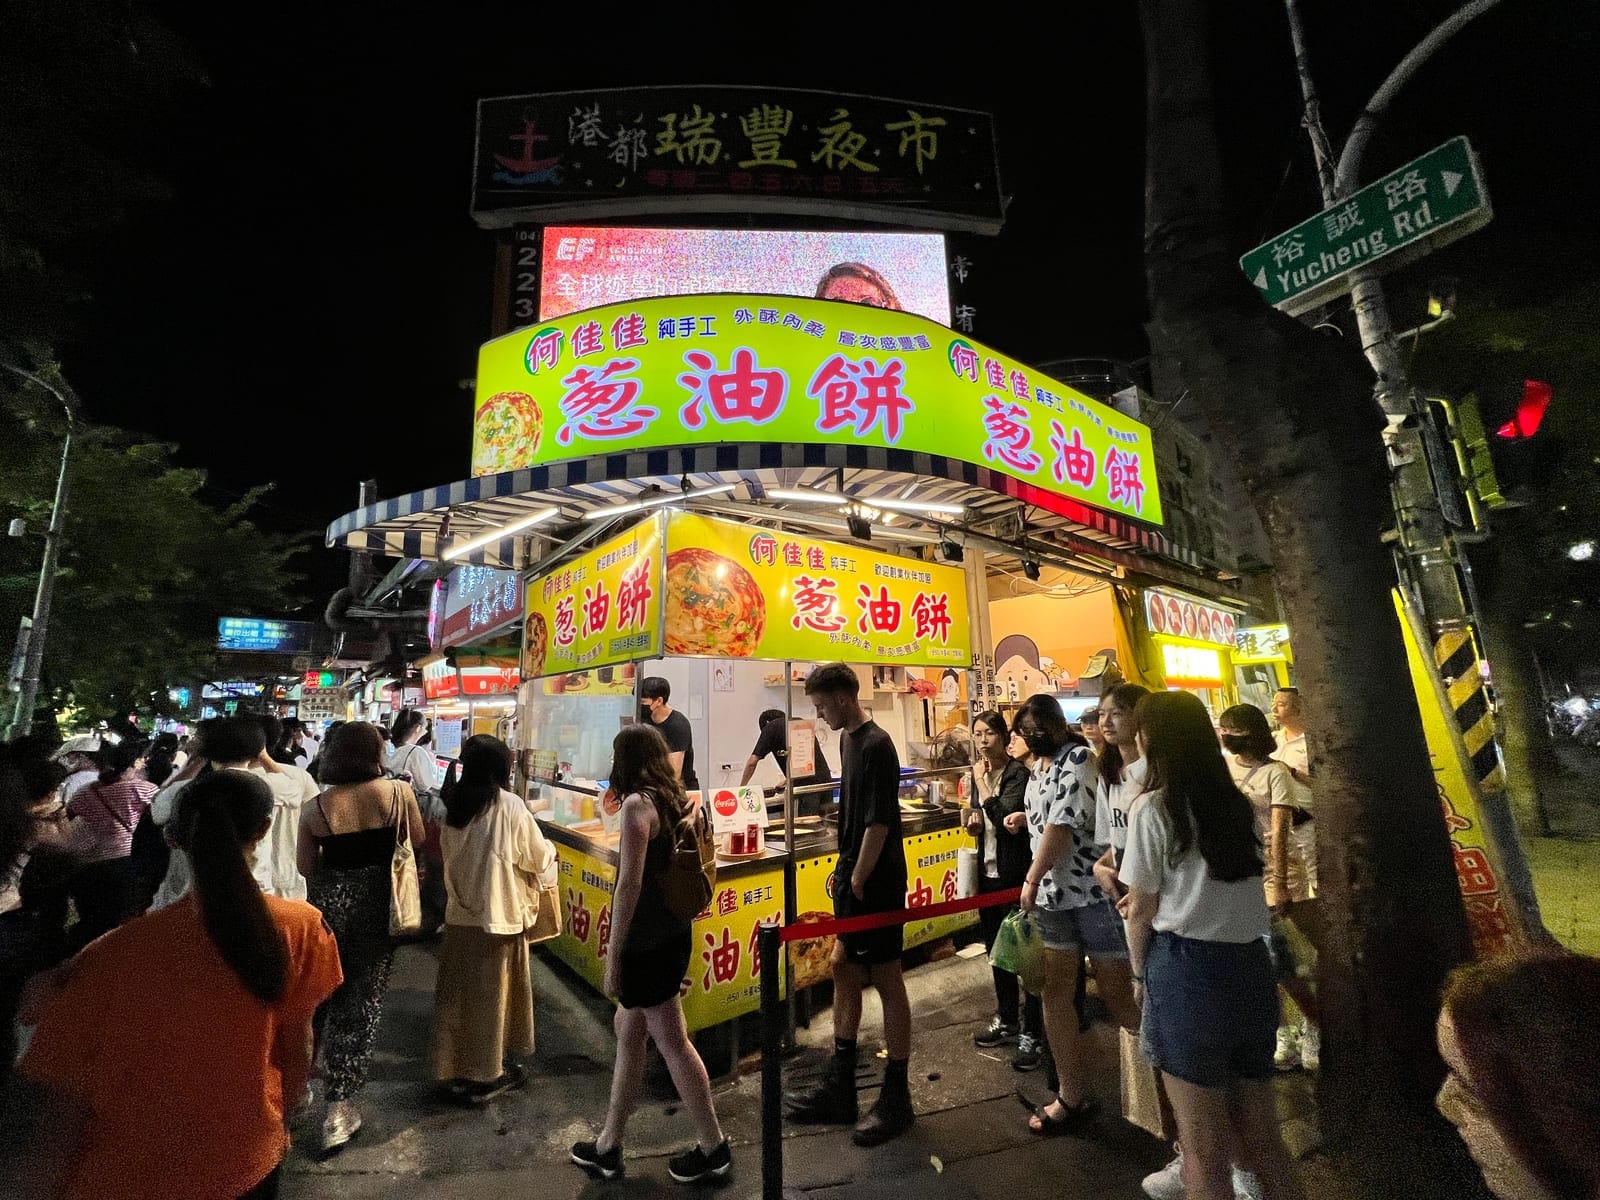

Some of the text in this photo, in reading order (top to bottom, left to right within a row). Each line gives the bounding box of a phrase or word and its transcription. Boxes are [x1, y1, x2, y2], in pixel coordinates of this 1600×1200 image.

[568, 102, 946, 175] 港都 瑞豐夜市
[1271, 169, 1428, 269] 裕誠路
[1277, 201, 1440, 293] Yucheng Rd.
[556, 238, 596, 260] EF
[528, 313, 648, 372] 何佳佳
[658, 316, 717, 340] 純手工
[838, 330, 931, 352] 層次感豐富
[951, 344, 1031, 403] 何佳佳
[752, 536, 825, 570] 何佳佳
[831, 556, 857, 574] 純手工
[743, 886, 772, 906] 純手工
